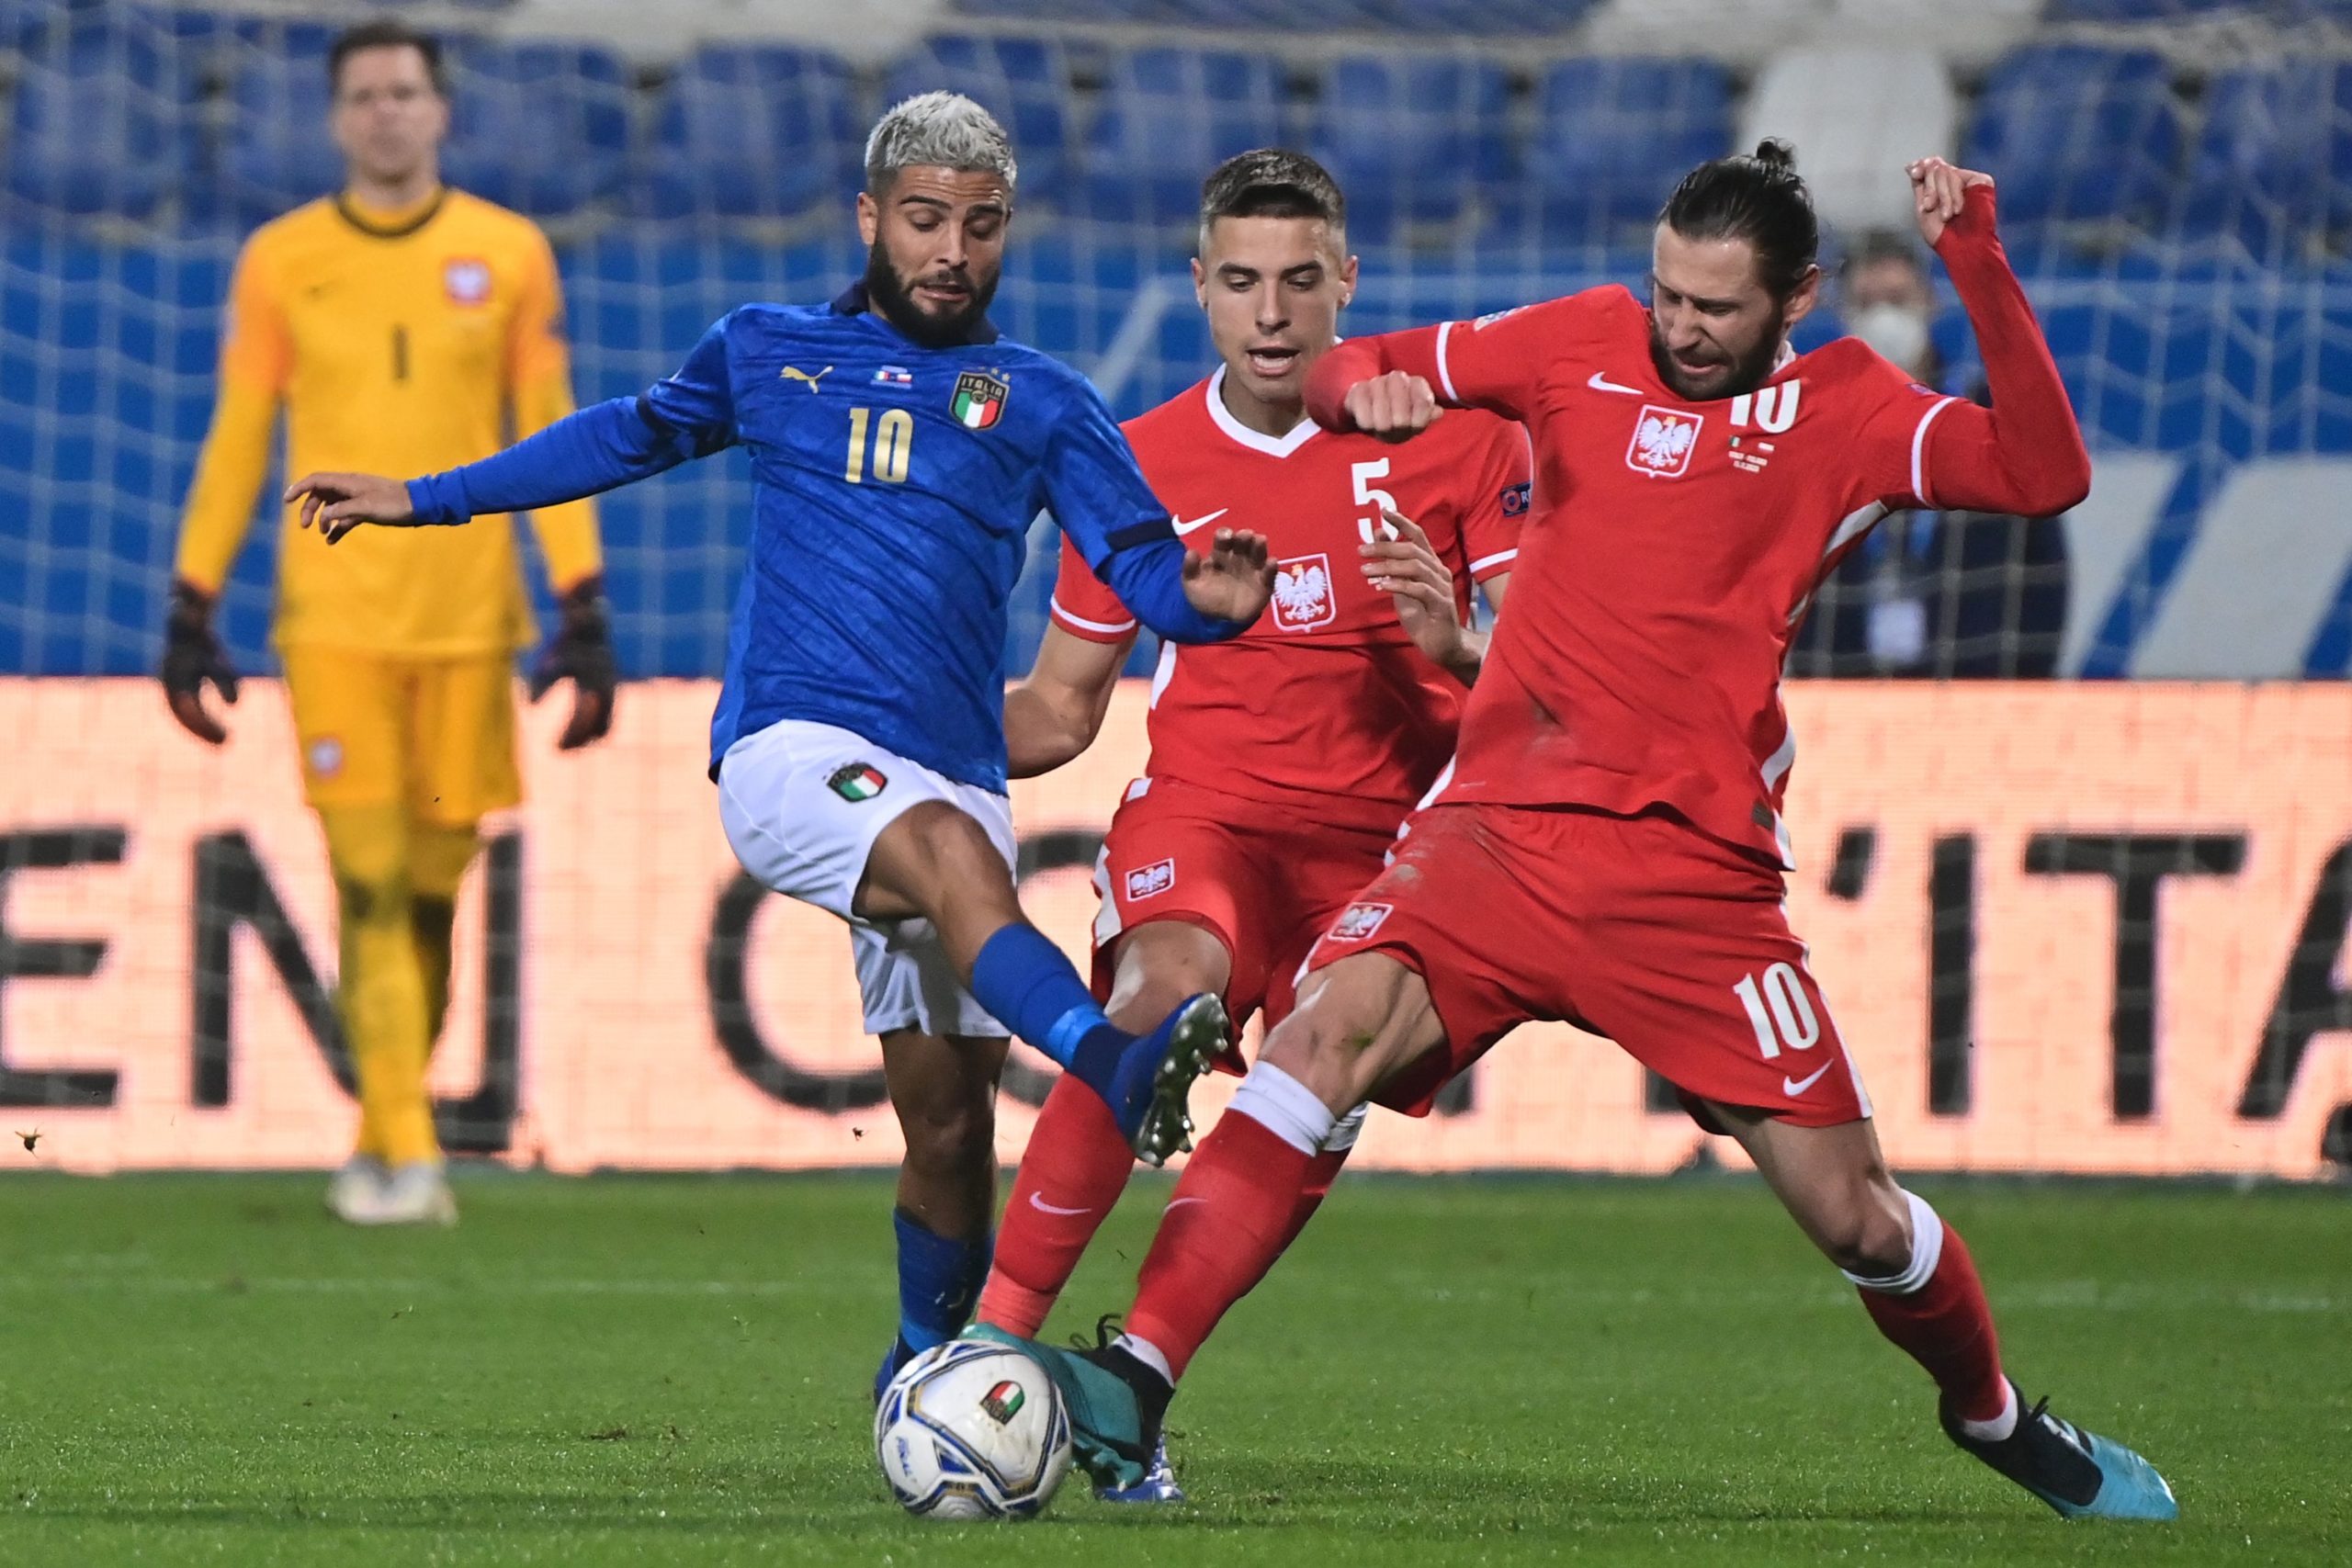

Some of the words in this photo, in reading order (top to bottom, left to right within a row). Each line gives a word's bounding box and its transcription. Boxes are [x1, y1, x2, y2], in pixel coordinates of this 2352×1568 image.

[392, 323, 408, 380] 1
[961, 377, 1003, 397] ITALIA
[845, 408, 913, 483] 10
[1351, 457, 1399, 544] 5
[1733, 962, 1820, 1059] 10
